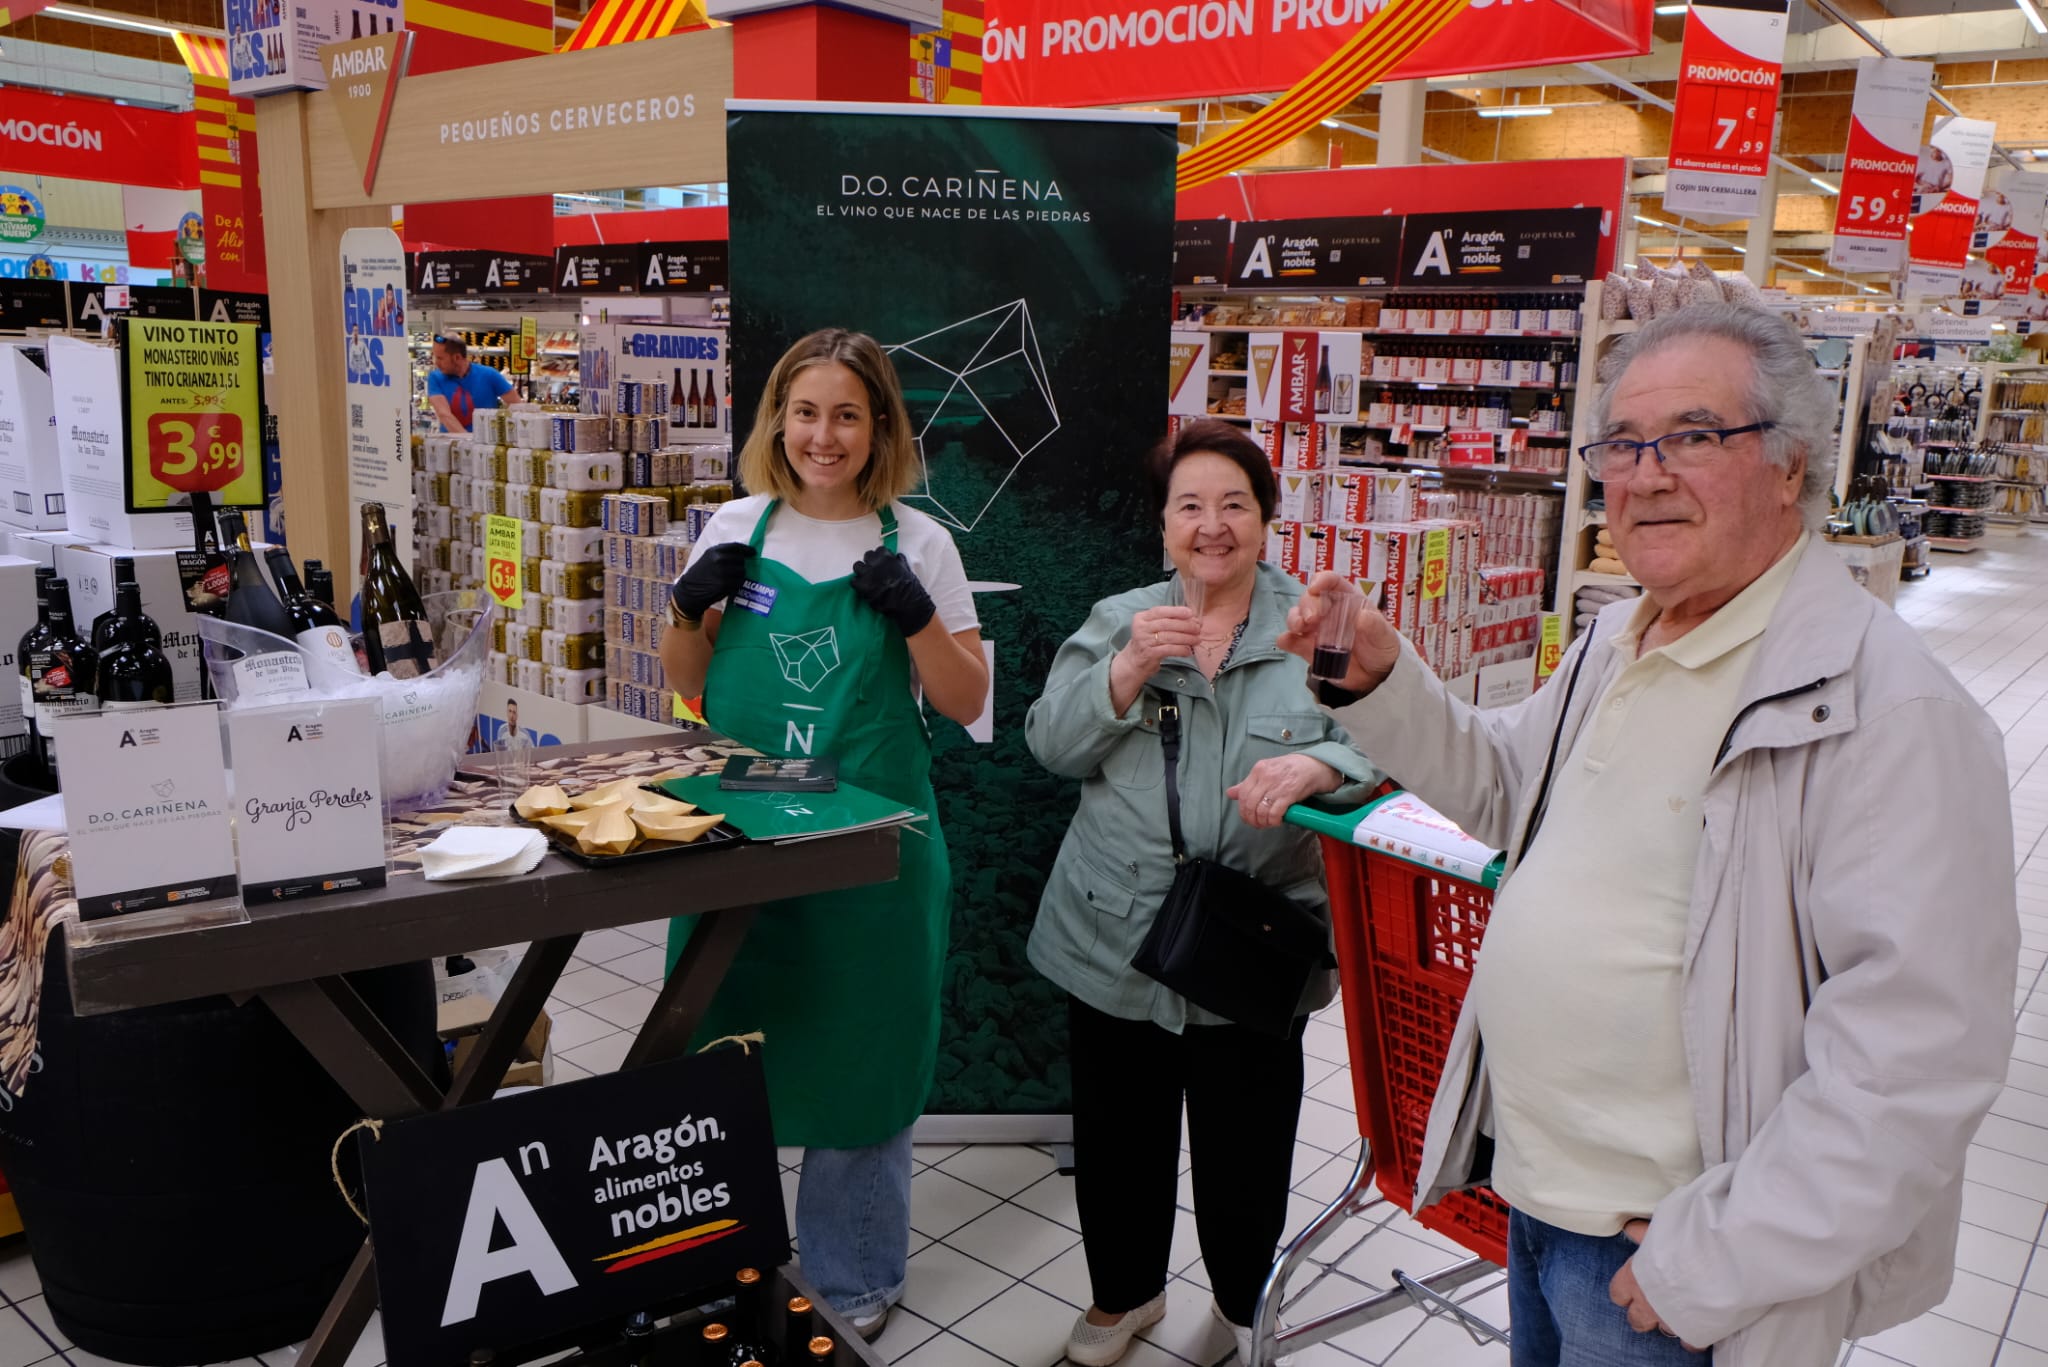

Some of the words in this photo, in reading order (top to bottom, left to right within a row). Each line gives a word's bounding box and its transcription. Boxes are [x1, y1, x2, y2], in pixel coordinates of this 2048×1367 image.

[1042, 0, 1254, 57] PROMOCIÓN
[331, 46, 387, 79] AMBAR
[1687, 64, 1776, 86] PROMOCIÓN
[349, 83, 371, 98] 1900
[440, 111, 541, 144] PEQUEÑOS
[550, 93, 696, 131] CERVECEROS
[1714, 118, 1737, 150] 7
[1850, 157, 1915, 174] PROMOCIÓN
[841, 175, 893, 197] D.O.
[215, 215, 232, 228] De
[817, 205, 834, 216] EL
[840, 206, 878, 217] VINO
[883, 206, 915, 220] QUE
[921, 208, 961, 220] NACE
[967, 208, 988, 220] DE
[994, 211, 1021, 222] LAS
[1026, 212, 1091, 224] PIEDRAS
[1461, 230, 1505, 245] Aragón,
[1283, 256, 1316, 267] nobles
[1463, 253, 1502, 264] nobles
[143, 326, 185, 344] VINO
[189, 328, 238, 345] TINTO
[1928, 329, 1944, 337] uso
[1946, 327, 1986, 336] intensivo
[1930, 317, 1968, 327] Sartenes
[144, 349, 208, 367] MONASTERIO
[210, 348, 239, 367] VIÑAS
[632, 333, 718, 360] GRANDES
[145, 371, 174, 387] TINTO
[176, 372, 217, 388] CRIANZA
[1291, 353, 1306, 414] AMBAR
[159, 420, 198, 476] 3
[1299, 424, 1310, 468] AMBAR
[1349, 475, 1361, 522] AMBAR
[489, 528, 516, 539] AMBAR
[1284, 522, 1295, 569] AMBAR
[1317, 525, 1329, 571] AMBAR
[1352, 529, 1364, 577] AMBAR
[1388, 533, 1400, 581] AMBAR
[491, 562, 503, 589] 6
[88, 812, 119, 825] D.O.
[246, 796, 312, 832] Granja
[309, 787, 373, 808] Perales
[588, 1113, 726, 1172] Aragón,
[594, 1160, 704, 1203] alimentos
[611, 1182, 731, 1237] nobles
